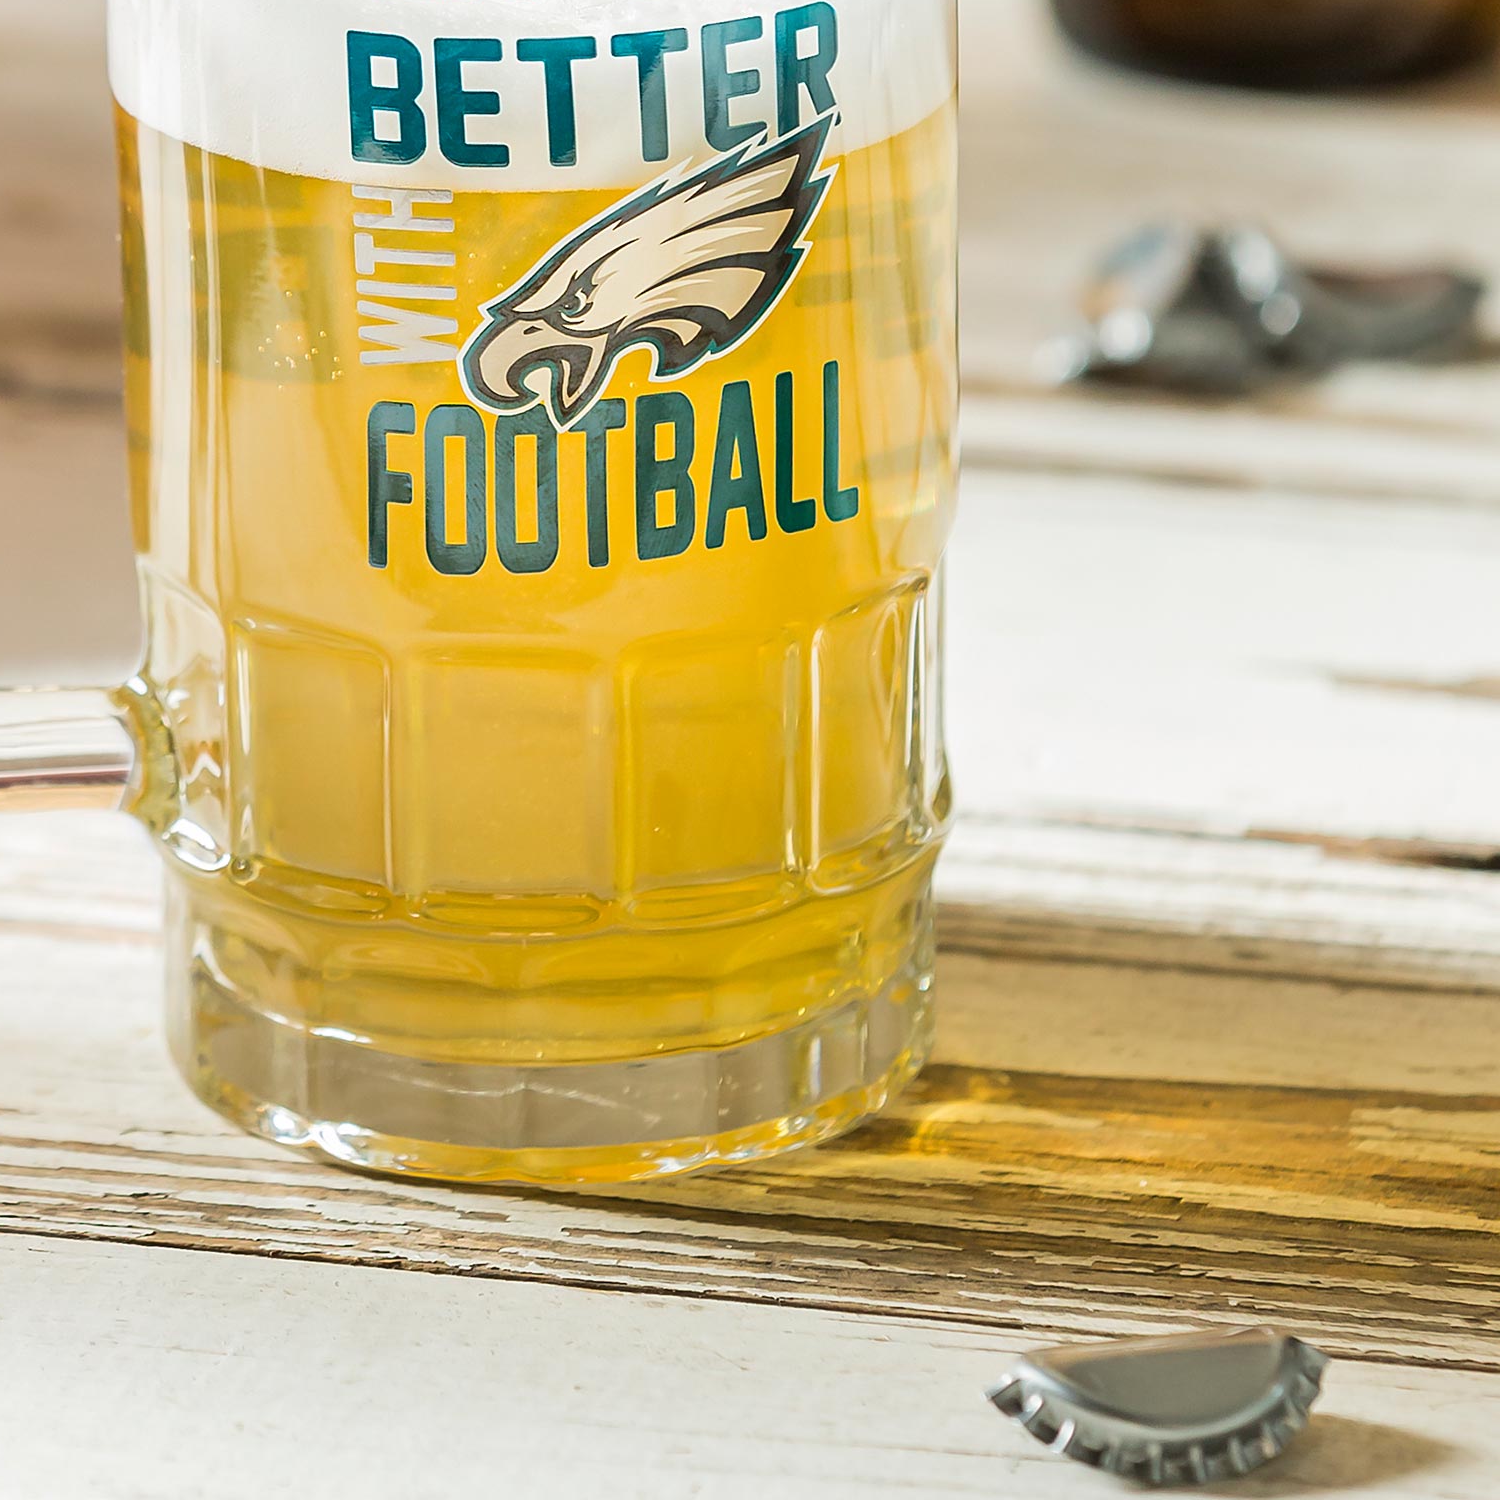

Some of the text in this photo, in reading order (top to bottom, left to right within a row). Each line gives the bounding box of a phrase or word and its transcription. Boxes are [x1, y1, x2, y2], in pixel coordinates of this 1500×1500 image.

[346, 1, 840, 168] BETTER
[352, 185, 459, 365] WITH
[367, 360, 859, 576] FOOTBALL
